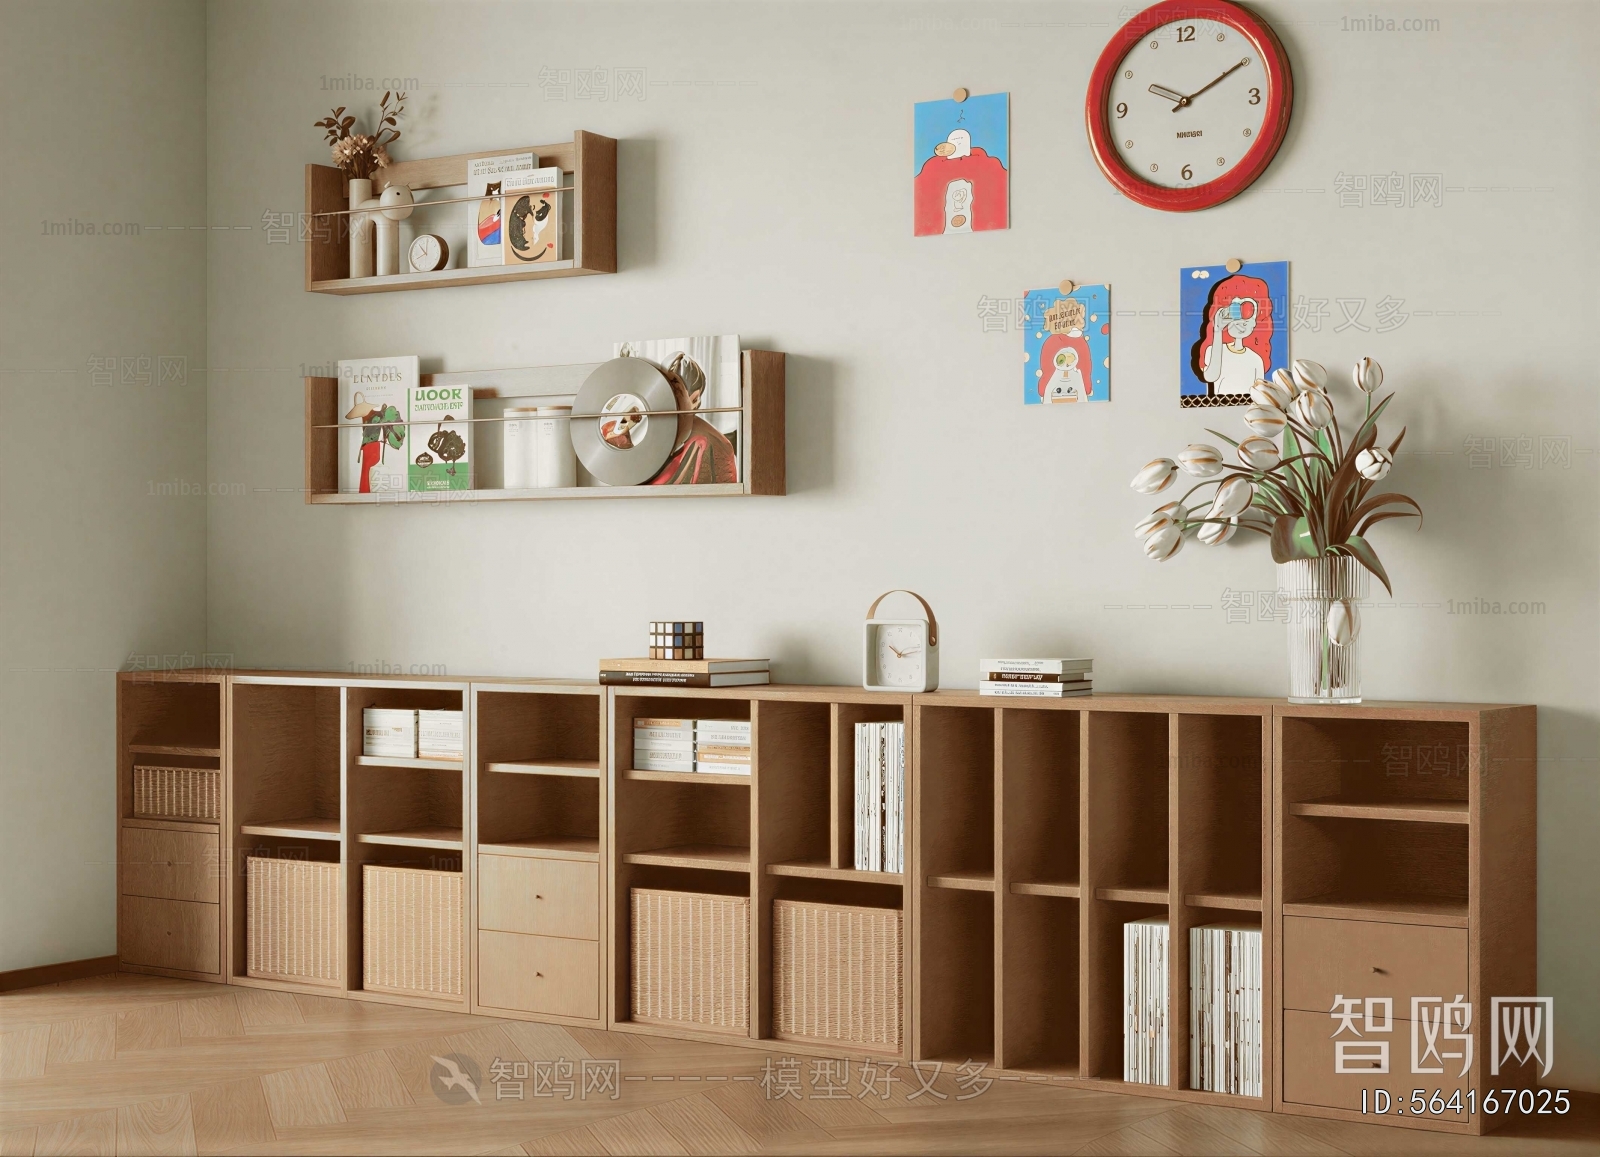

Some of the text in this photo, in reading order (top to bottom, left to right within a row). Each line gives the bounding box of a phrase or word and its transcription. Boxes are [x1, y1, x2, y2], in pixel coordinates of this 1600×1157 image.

[1176, 25, 1196, 43] 12
[1248, 87, 1261, 105] 3
[1116, 102, 1128, 119] 9
[1181, 164, 1193, 181] 6
